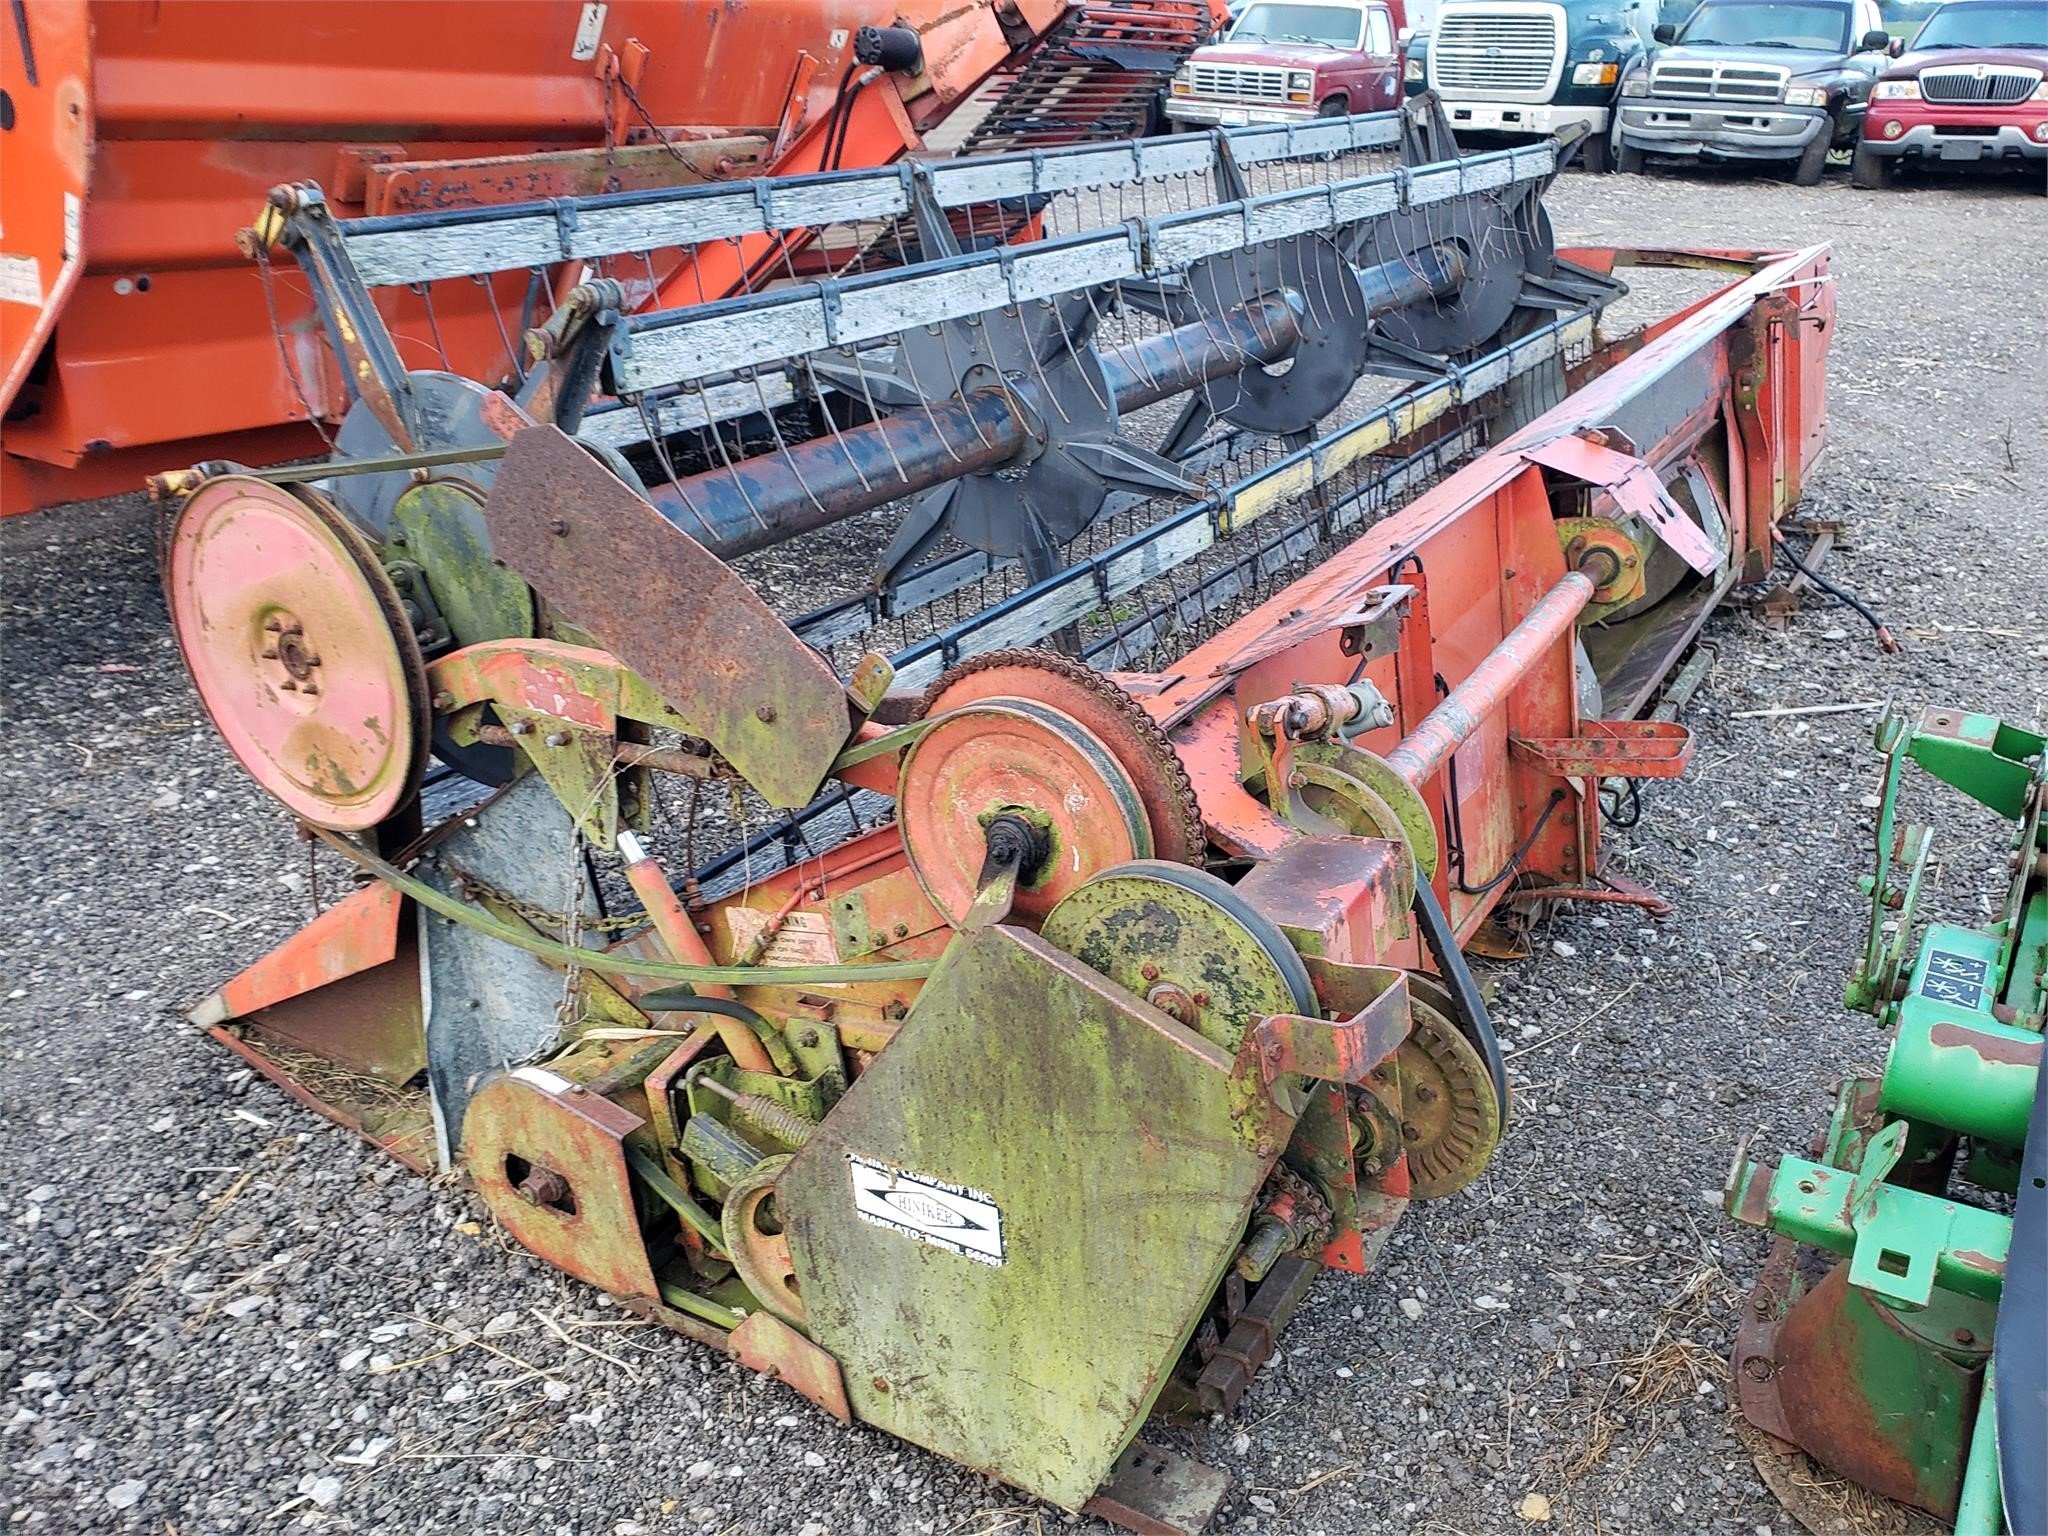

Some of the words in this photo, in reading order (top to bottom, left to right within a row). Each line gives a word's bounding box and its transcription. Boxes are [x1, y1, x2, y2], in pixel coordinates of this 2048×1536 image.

[900, 1168, 965, 1196] COMPANY
[898, 1195, 954, 1225] HINIKER
[965, 1247, 1003, 1268] 56001
